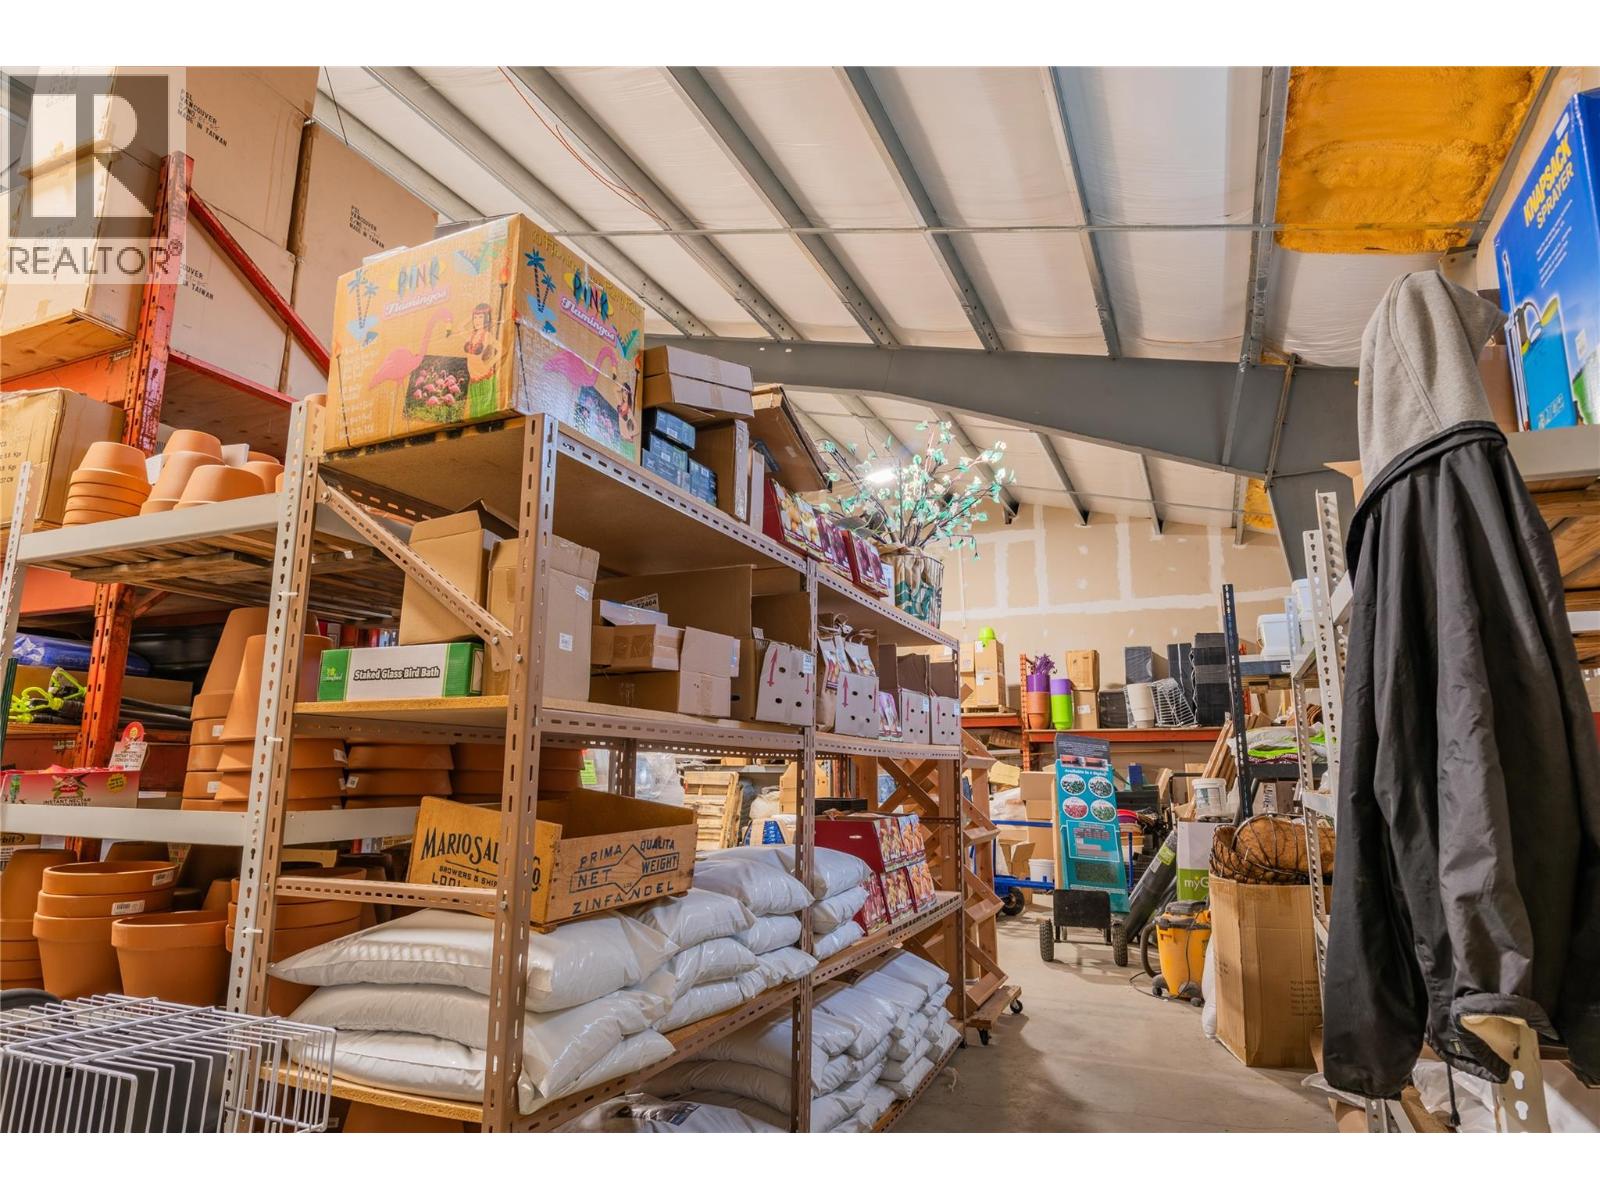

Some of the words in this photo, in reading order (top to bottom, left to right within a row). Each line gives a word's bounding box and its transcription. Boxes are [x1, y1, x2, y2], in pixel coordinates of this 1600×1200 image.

[179, 95, 217, 124] VANCOUVER
[196, 122, 203, 130] IN
[205, 127, 227, 147] TAIWAN
[1523, 132, 1572, 228] KNAPSACK
[1536, 161, 1574, 230] SPRAYER
[351, 210, 377, 231] VANCOUVER
[369, 234, 385, 249] TAIWAN
[397, 256, 440, 300] PINK
[191, 282, 214, 300] TAIWAN
[573, 269, 609, 322] PINK
[562, 297, 615, 342] Flamingos
[353, 668, 381, 681] Staked
[381, 666, 404, 680] Glass
[403, 665, 421, 678] Bird
[420, 664, 441, 678] Bath
[468, 836, 499, 865] SAL
[580, 844, 623, 868] PRIMA
[440, 866, 472, 880] GROWERS
[480, 877, 498, 888] SHIP
[642, 855, 677, 875] WEIGHT
[577, 868, 612, 889] NET
[1184, 876, 1210, 891] myG
